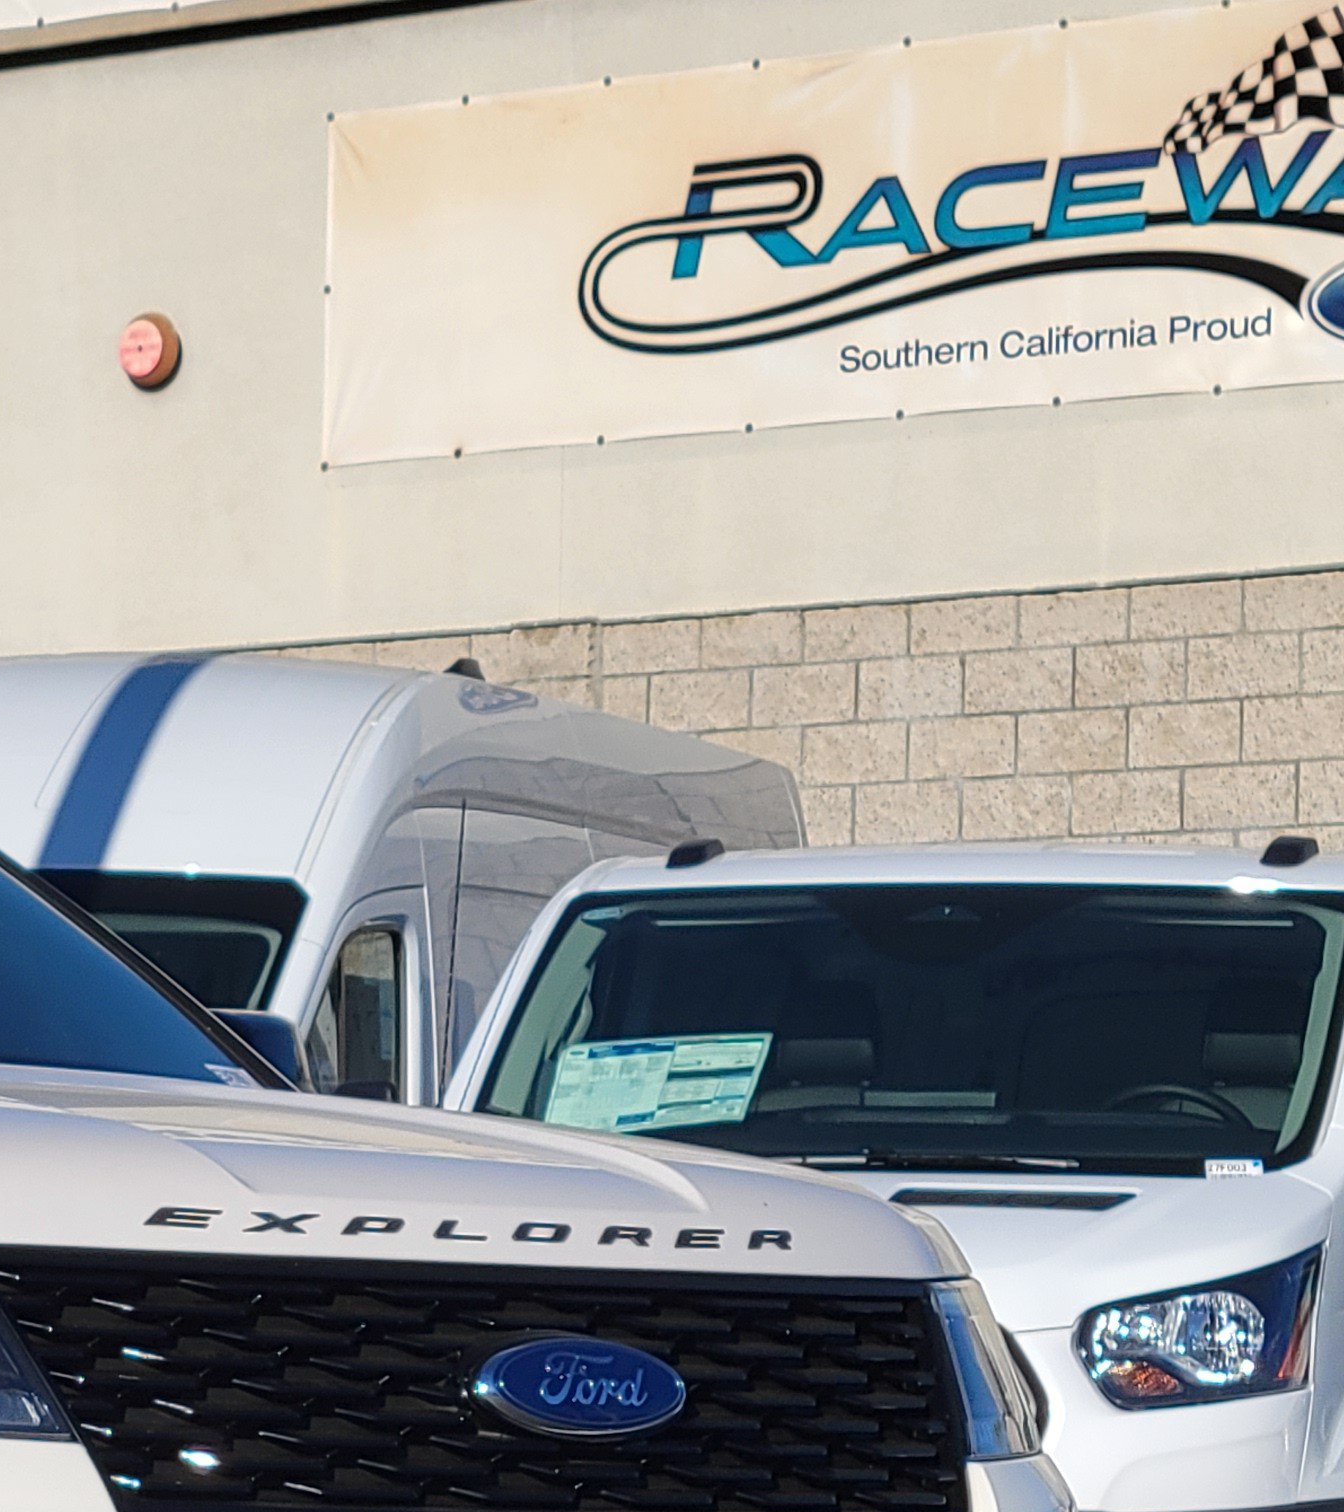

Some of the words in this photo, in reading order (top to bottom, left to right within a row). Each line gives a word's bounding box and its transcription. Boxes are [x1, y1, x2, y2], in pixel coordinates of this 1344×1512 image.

[839, 338, 989, 374] Southern
[999, 318, 1158, 359] California
[1168, 307, 1273, 343] Proud
[143, 1206, 794, 1252] EXPLORER
[539, 1351, 649, 1407] Ford
